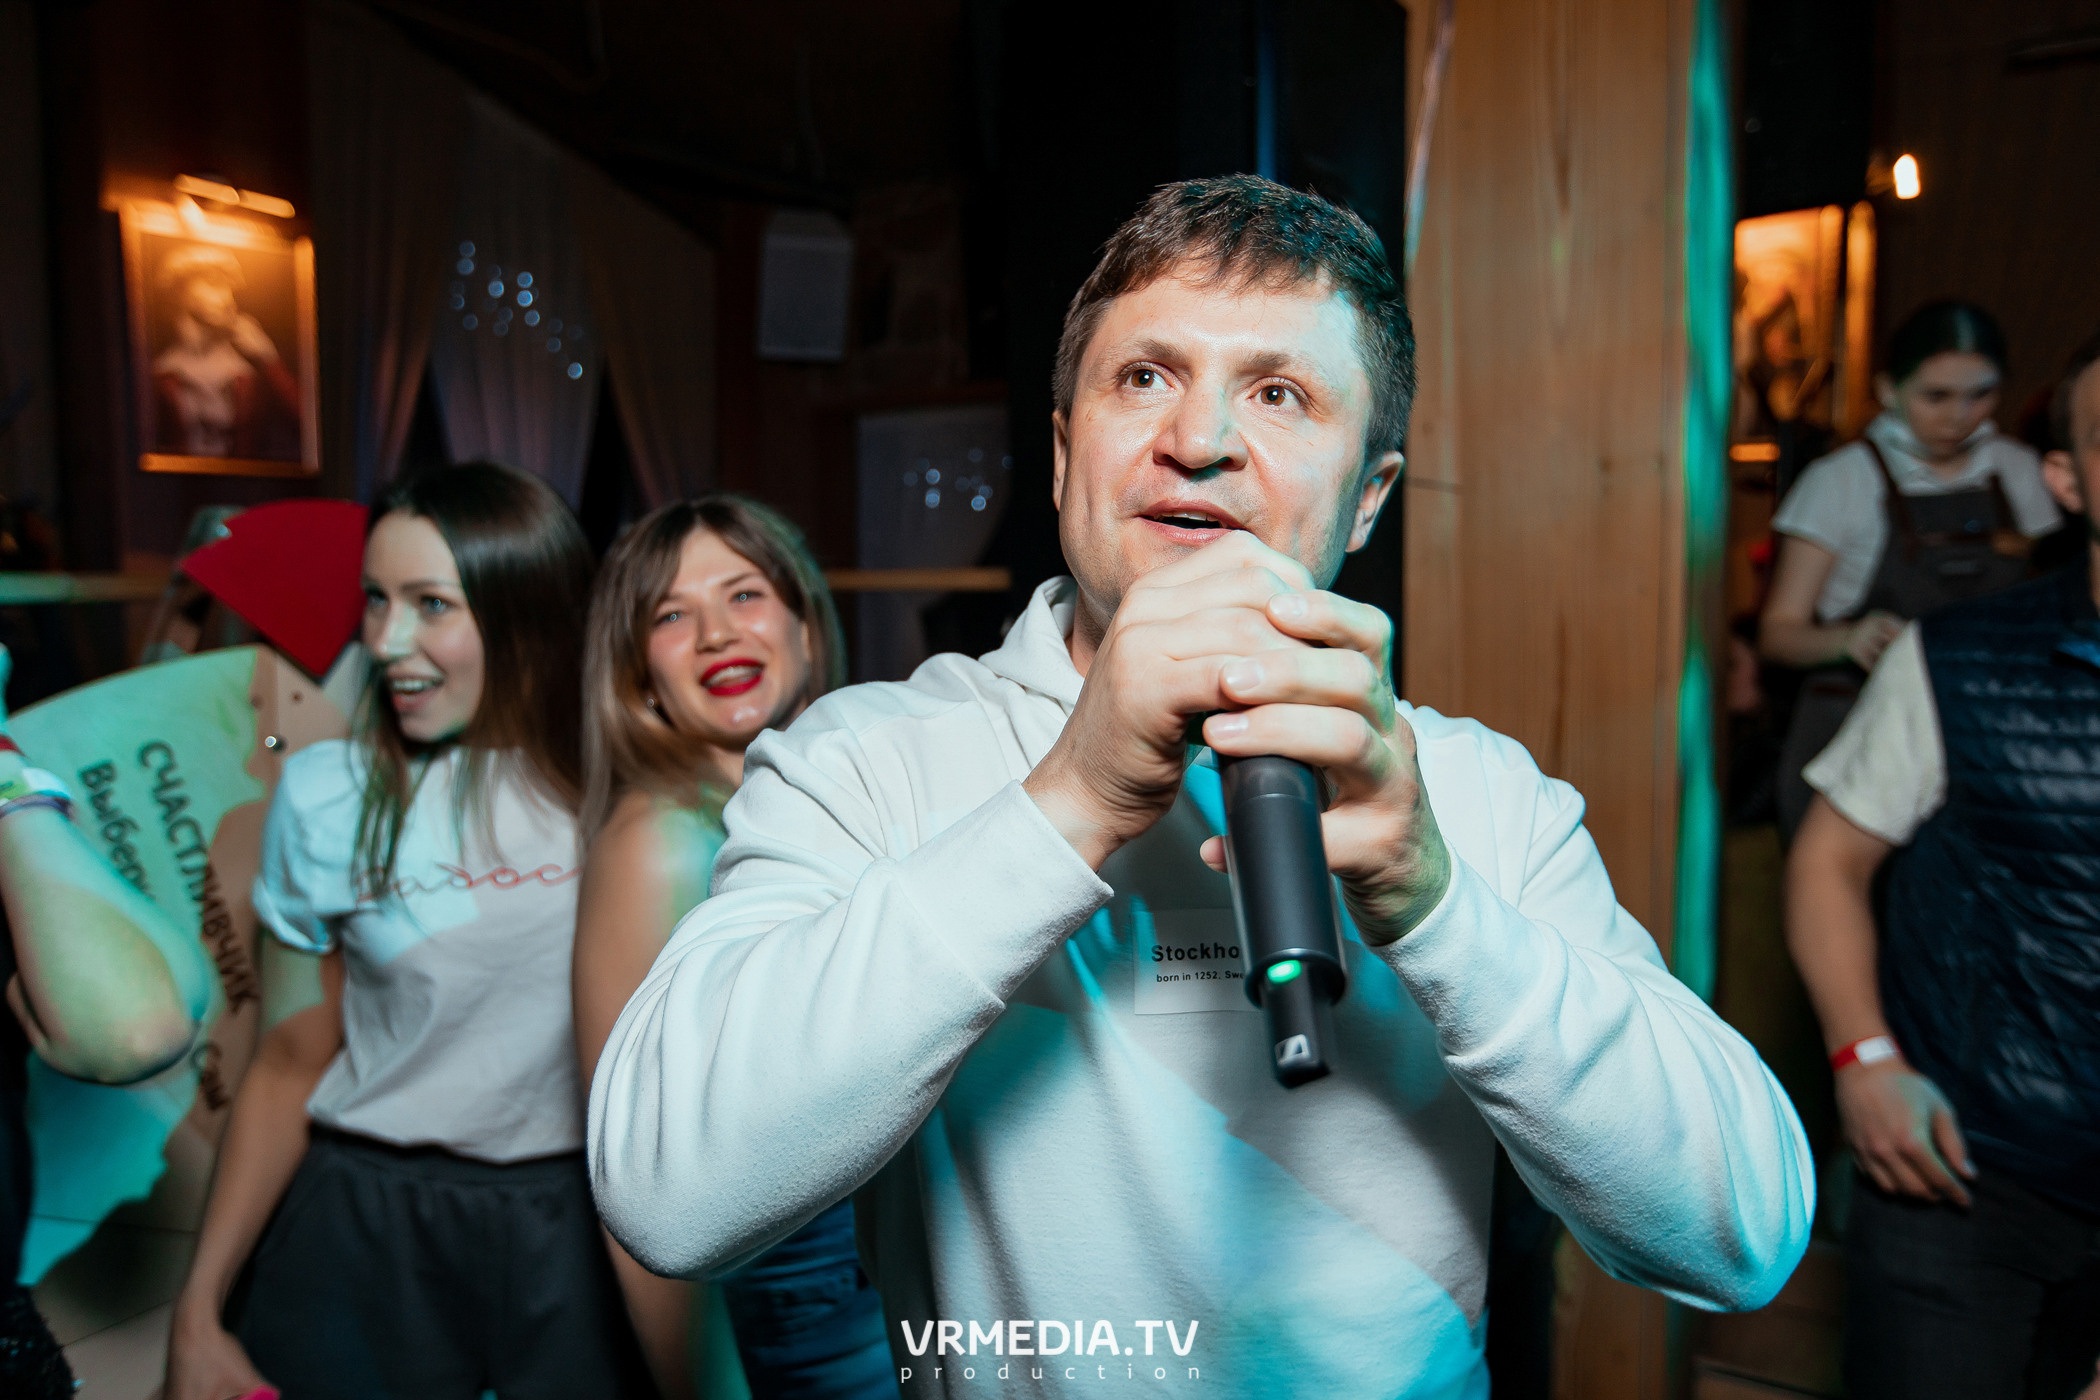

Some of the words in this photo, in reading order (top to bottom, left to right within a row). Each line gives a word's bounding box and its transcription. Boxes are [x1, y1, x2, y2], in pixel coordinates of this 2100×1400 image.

[77, 759, 154, 902] Выбер
[138, 737, 259, 1016] СЧАСТЛИВЧИК
[1151, 942, 1240, 962] Stockho
[1156, 974, 1180, 983] born
[1182, 972, 1191, 980] in
